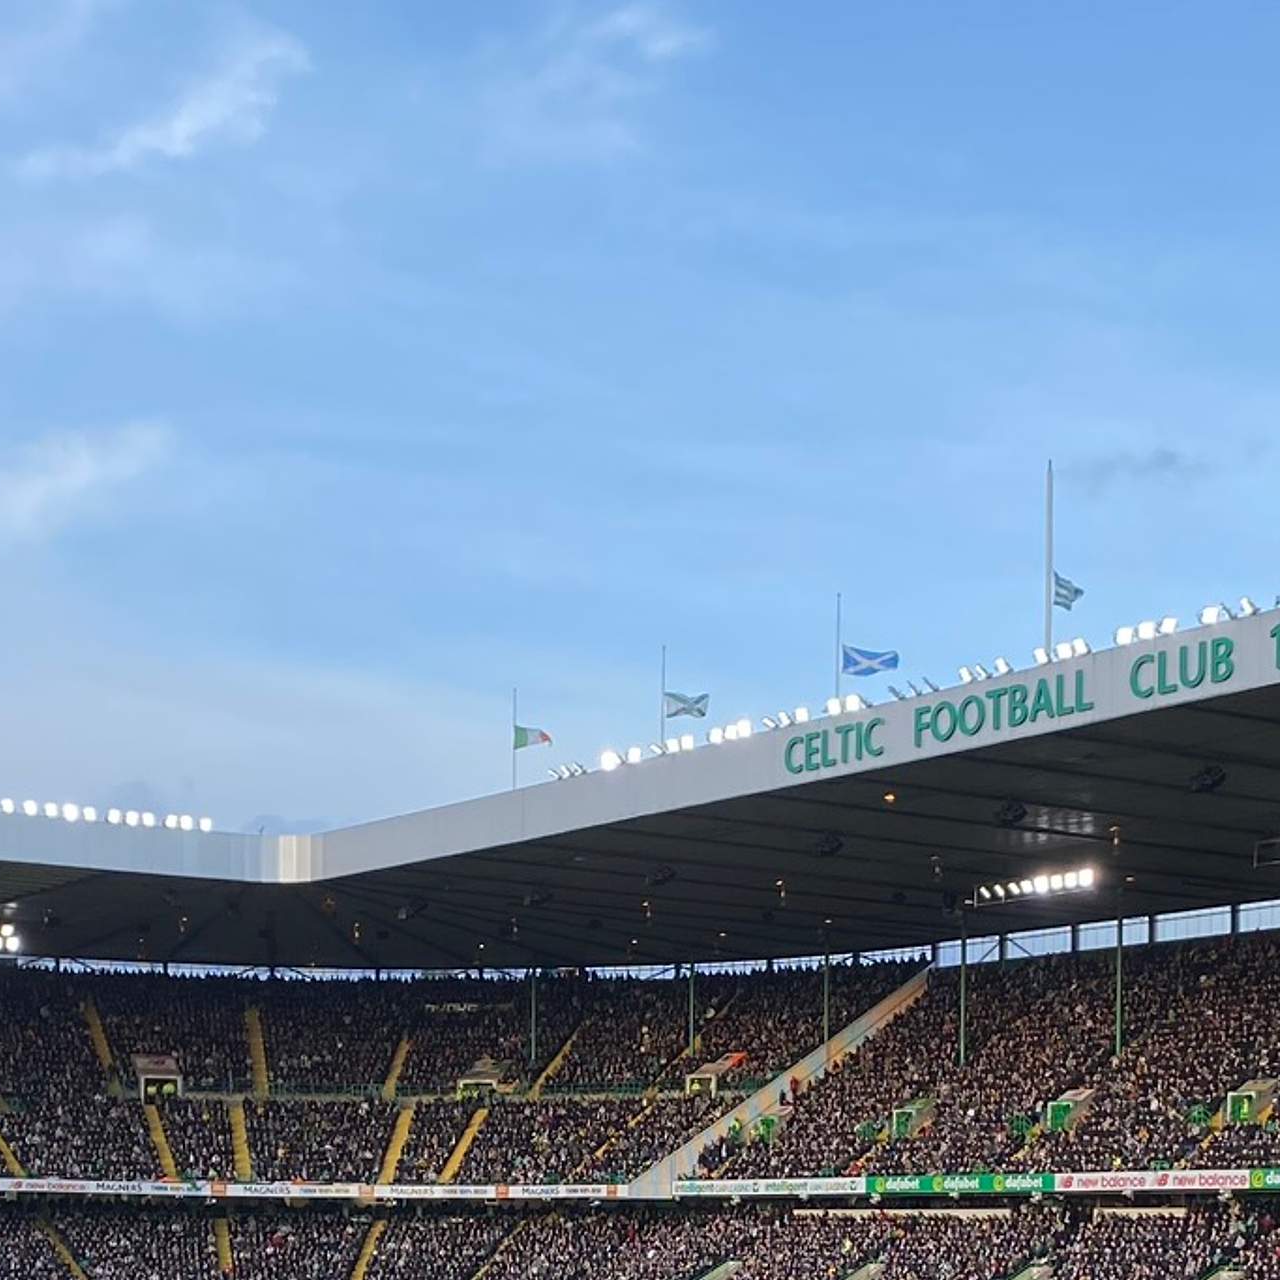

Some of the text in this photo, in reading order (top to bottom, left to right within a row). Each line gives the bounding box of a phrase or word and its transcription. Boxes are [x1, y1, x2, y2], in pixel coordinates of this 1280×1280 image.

[784, 716, 885, 774] CELTIC
[914, 670, 1094, 748] FOOTBALL
[1130, 636, 1236, 699] CLUB
[25, 1182, 45, 1190] new
[47, 1180, 87, 1191] balance
[886, 1177, 920, 1191] dafabet
[943, 1177, 980, 1191] dafabet
[1006, 1175, 1043, 1190] dafabet
[1077, 1178, 1099, 1188] new
[1101, 1175, 1147, 1188] balance
[1173, 1176, 1197, 1187] new
[1198, 1173, 1247, 1187] balance
[96, 1182, 143, 1192] MAGNERS
[243, 1184, 290, 1195] MAGNERS
[390, 1186, 434, 1196] MAGNERS
[522, 1186, 560, 1196] MAGNERS
